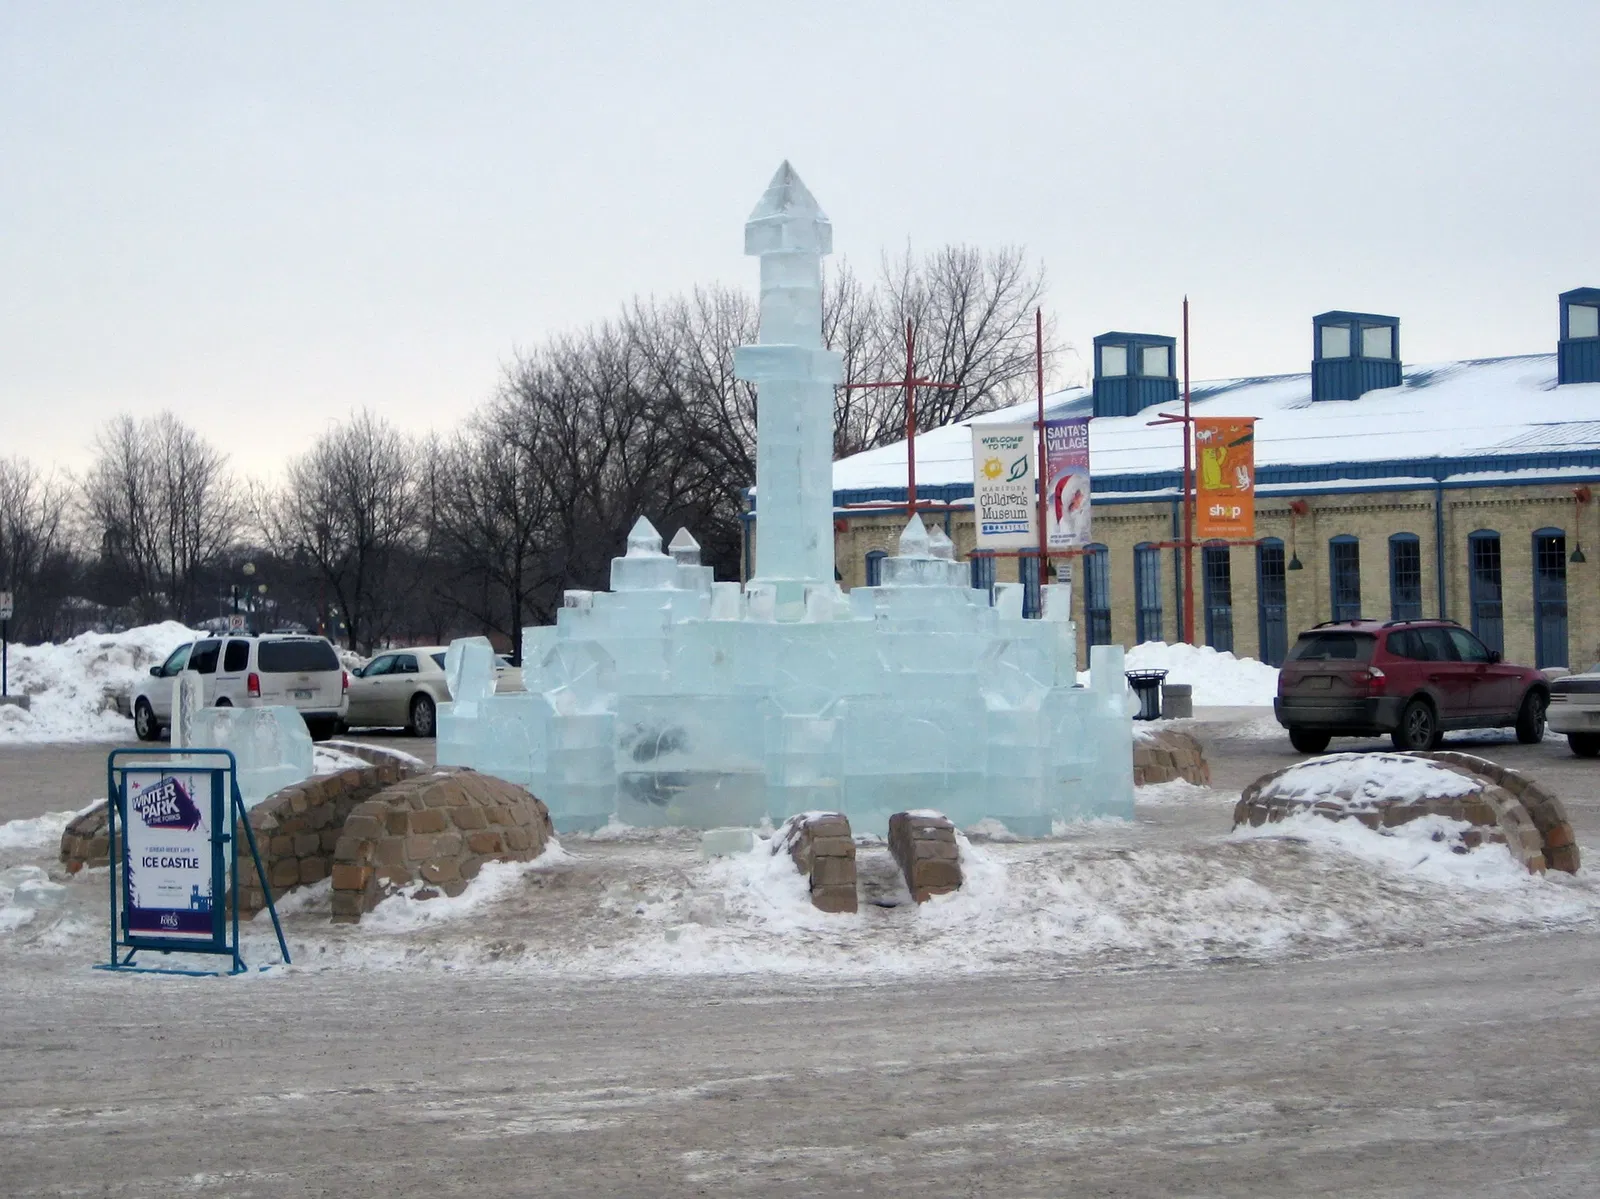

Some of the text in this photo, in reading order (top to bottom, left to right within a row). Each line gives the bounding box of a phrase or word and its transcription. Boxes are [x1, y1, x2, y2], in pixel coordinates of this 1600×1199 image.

[1047, 425, 1087, 438] SANTA'S
[981, 436, 1024, 444] WELCOME
[1047, 436, 1088, 451] VILLAGE
[980, 492, 1028, 507] Children's
[981, 507, 1028, 520] Museum
[1209, 503, 1241, 519] shop
[132, 783, 176, 809] WINTER
[142, 796, 180, 819] PARK
[162, 813, 181, 823] FORKS
[142, 856, 199, 869] ICE CASTLE
